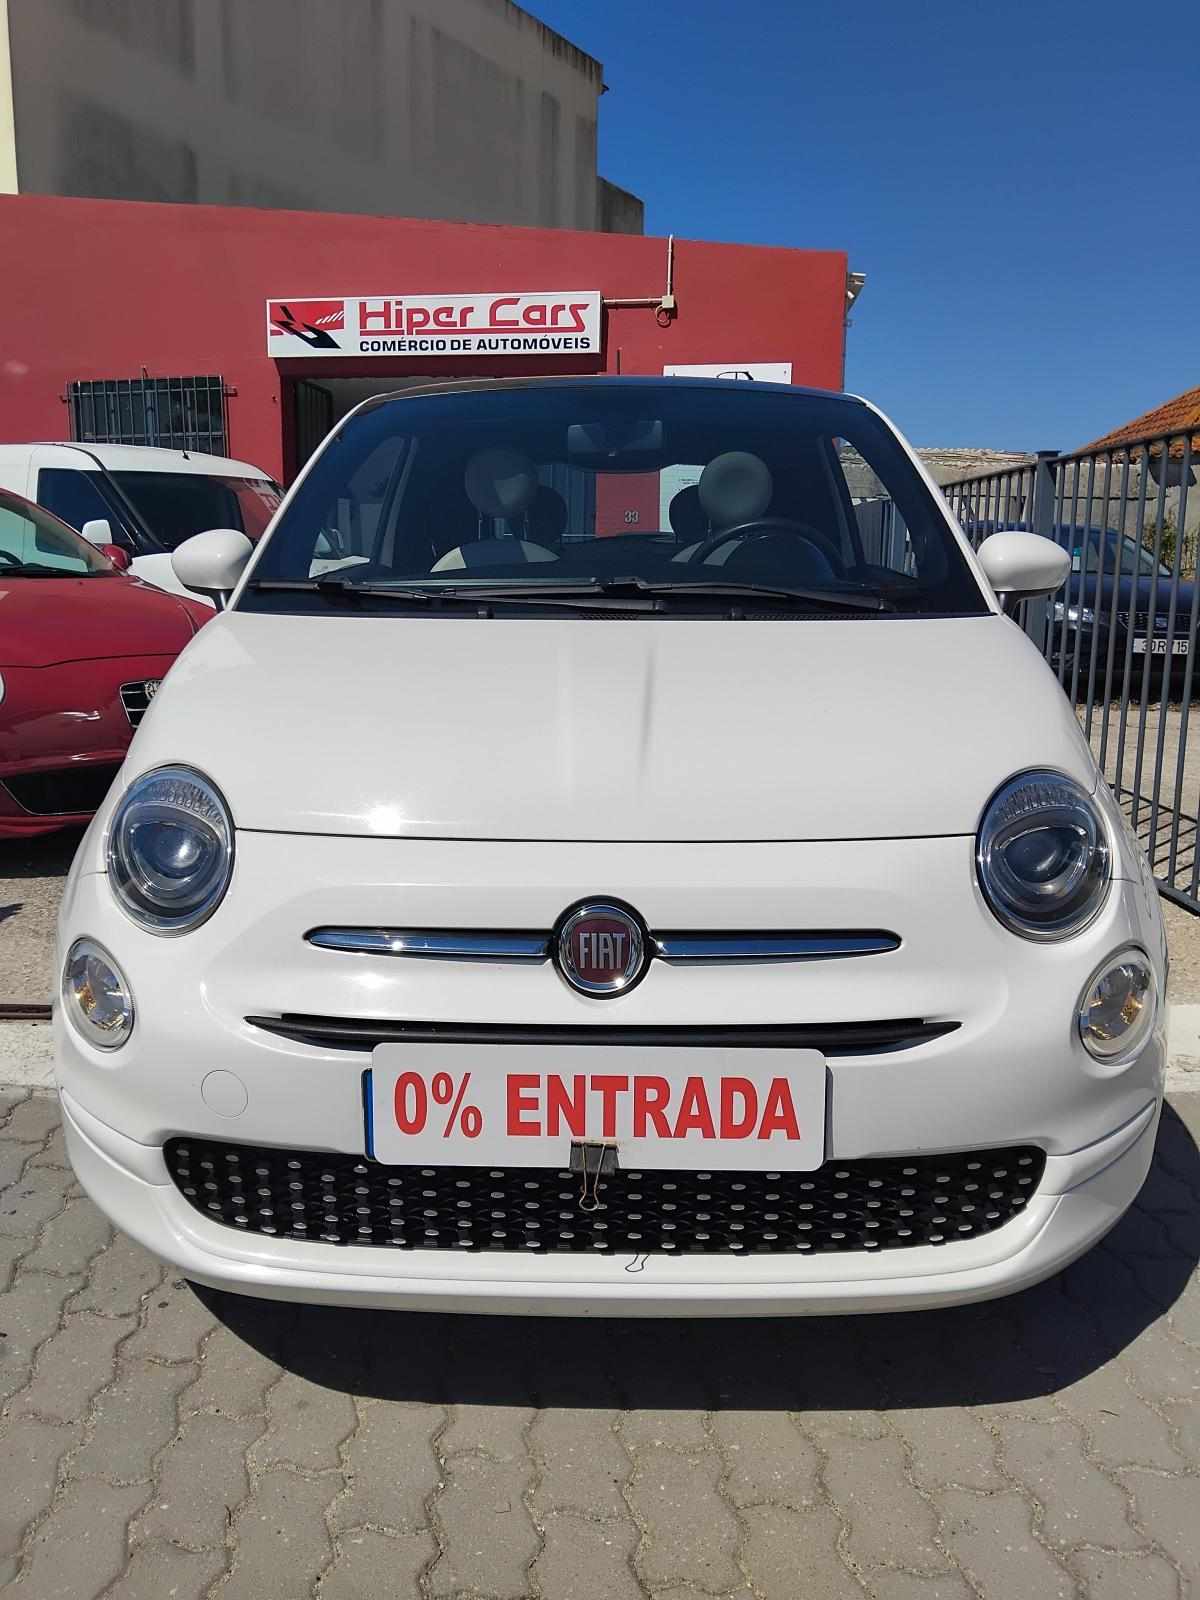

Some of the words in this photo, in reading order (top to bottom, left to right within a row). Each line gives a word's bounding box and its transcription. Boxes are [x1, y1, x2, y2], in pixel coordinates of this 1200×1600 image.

[359, 299, 475, 334] Hiper
[489, 297, 590, 333] Cars
[359, 335, 448, 352] COMÉRCIO
[450, 338, 473, 351] DE
[476, 334, 591, 351] AUTOMÓVEIS
[579, 932, 626, 970] FIAT
[393, 1071, 483, 1138] 0%
[506, 1073, 801, 1140] ENTRADA
